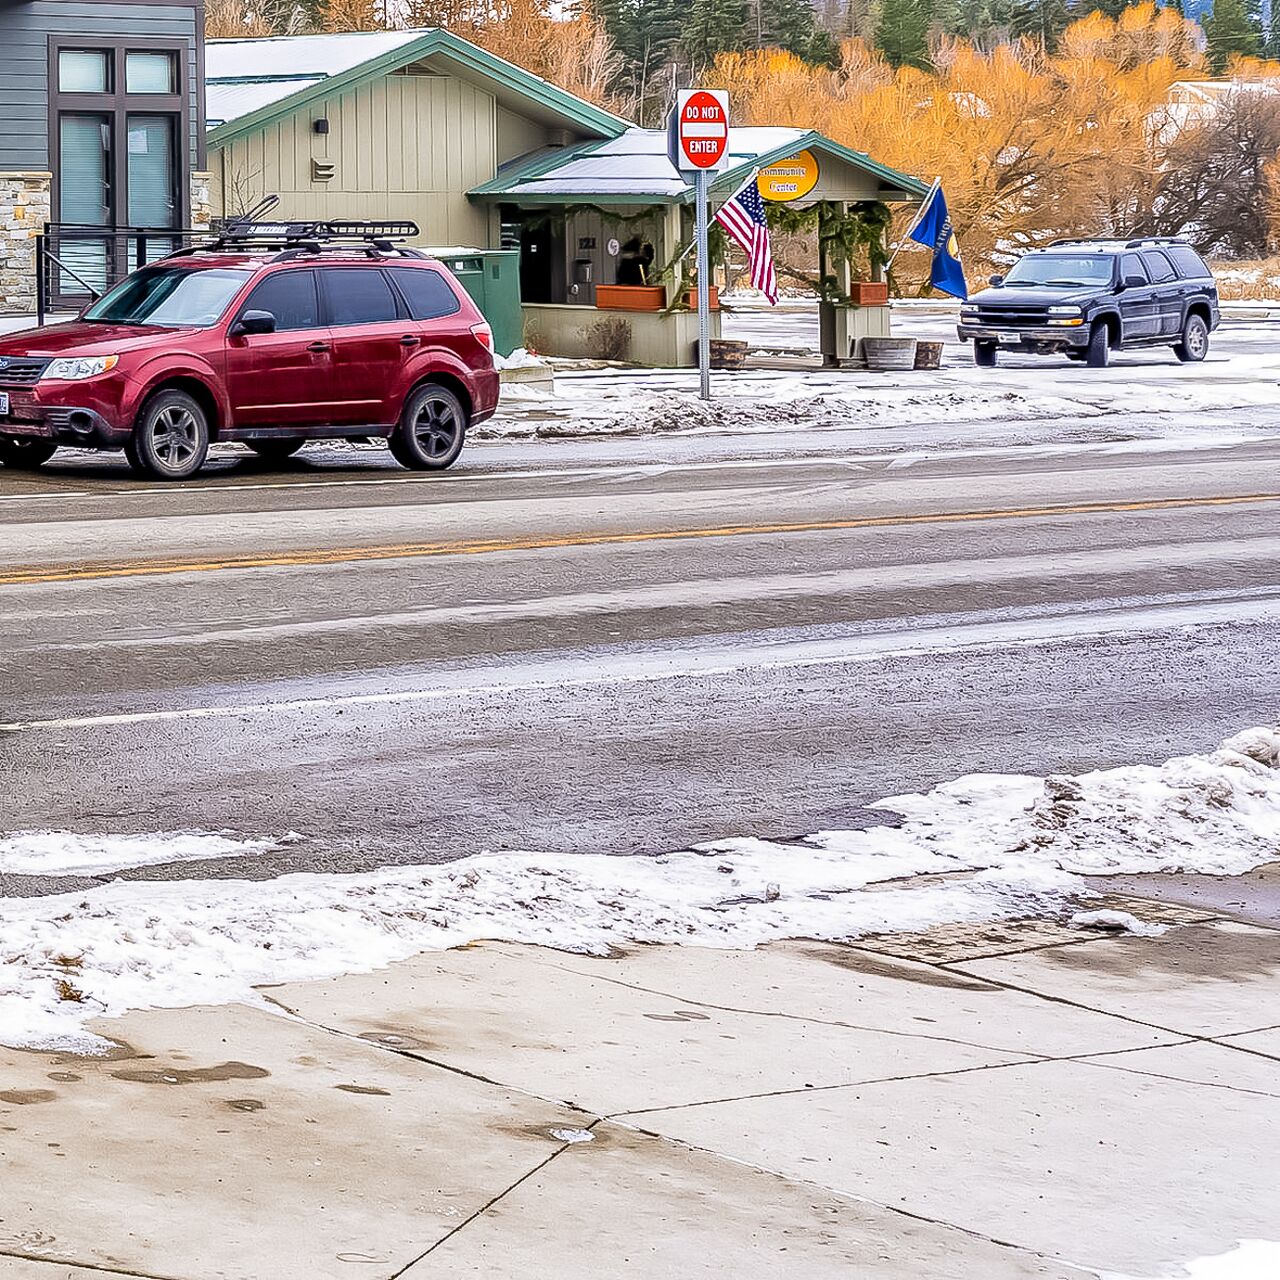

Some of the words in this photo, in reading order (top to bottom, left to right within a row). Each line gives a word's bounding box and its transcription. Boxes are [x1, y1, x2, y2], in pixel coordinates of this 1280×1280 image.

[686, 106, 699, 119] DO
[701, 106, 720, 119] NOT
[689, 140, 718, 153] ENTER
